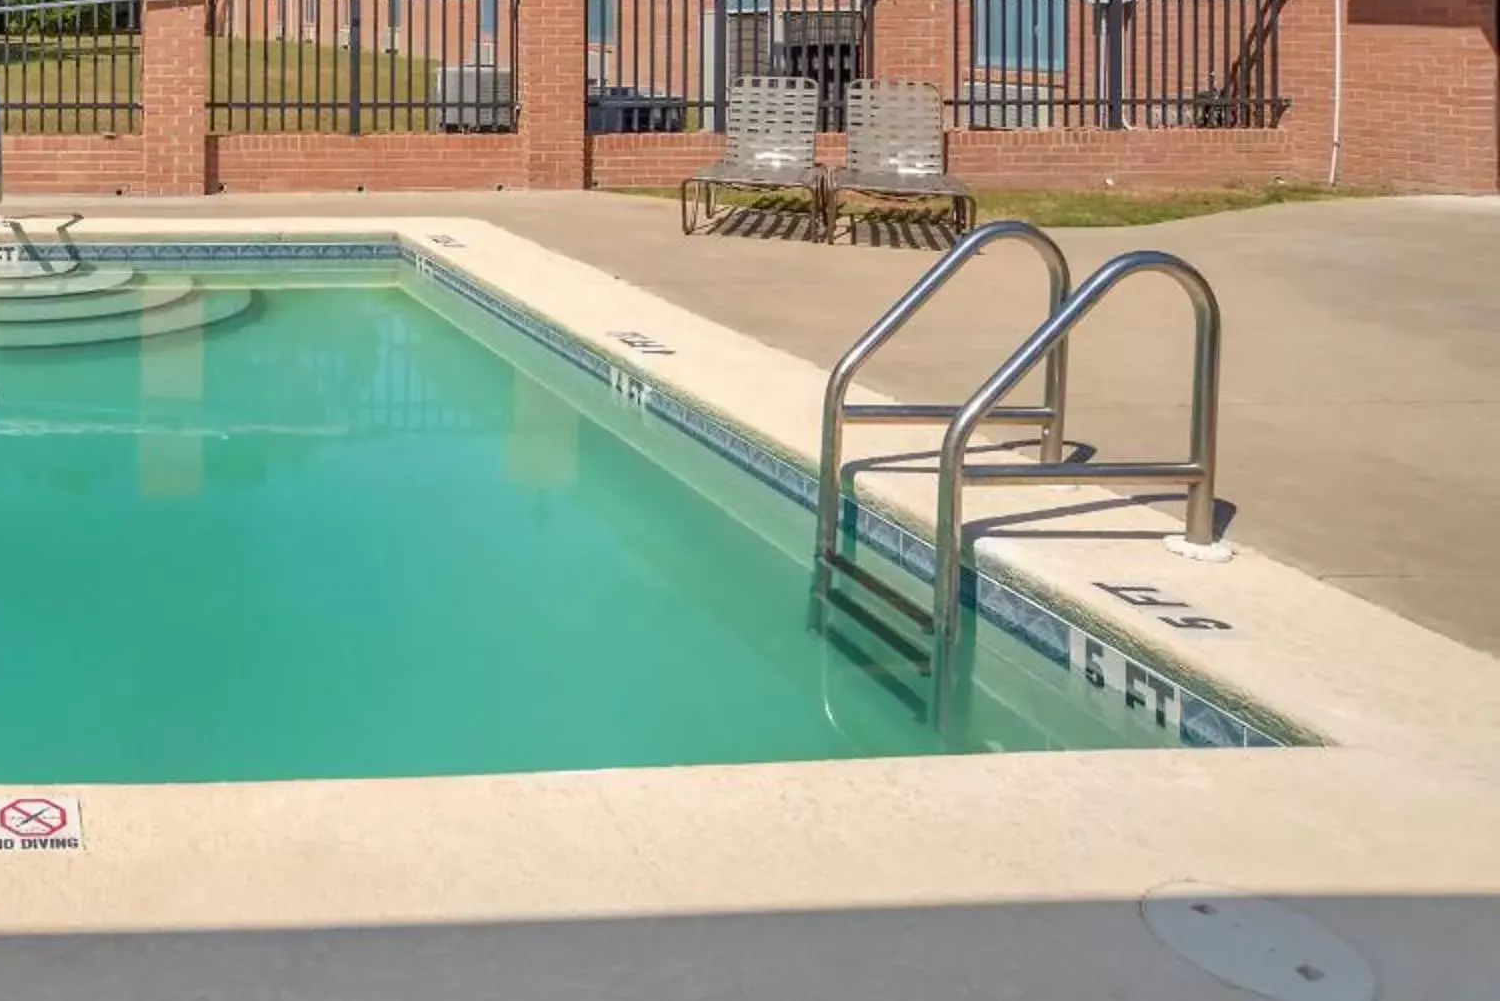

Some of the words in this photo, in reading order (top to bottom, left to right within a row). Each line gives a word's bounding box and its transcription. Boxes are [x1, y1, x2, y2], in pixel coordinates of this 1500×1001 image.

[1090, 581, 1191, 608] FT
[1156, 616, 1233, 630] 5
[1085, 636, 1105, 689] 5
[1124, 658, 1175, 729] FT
[21, 836, 79, 850] DIVING
